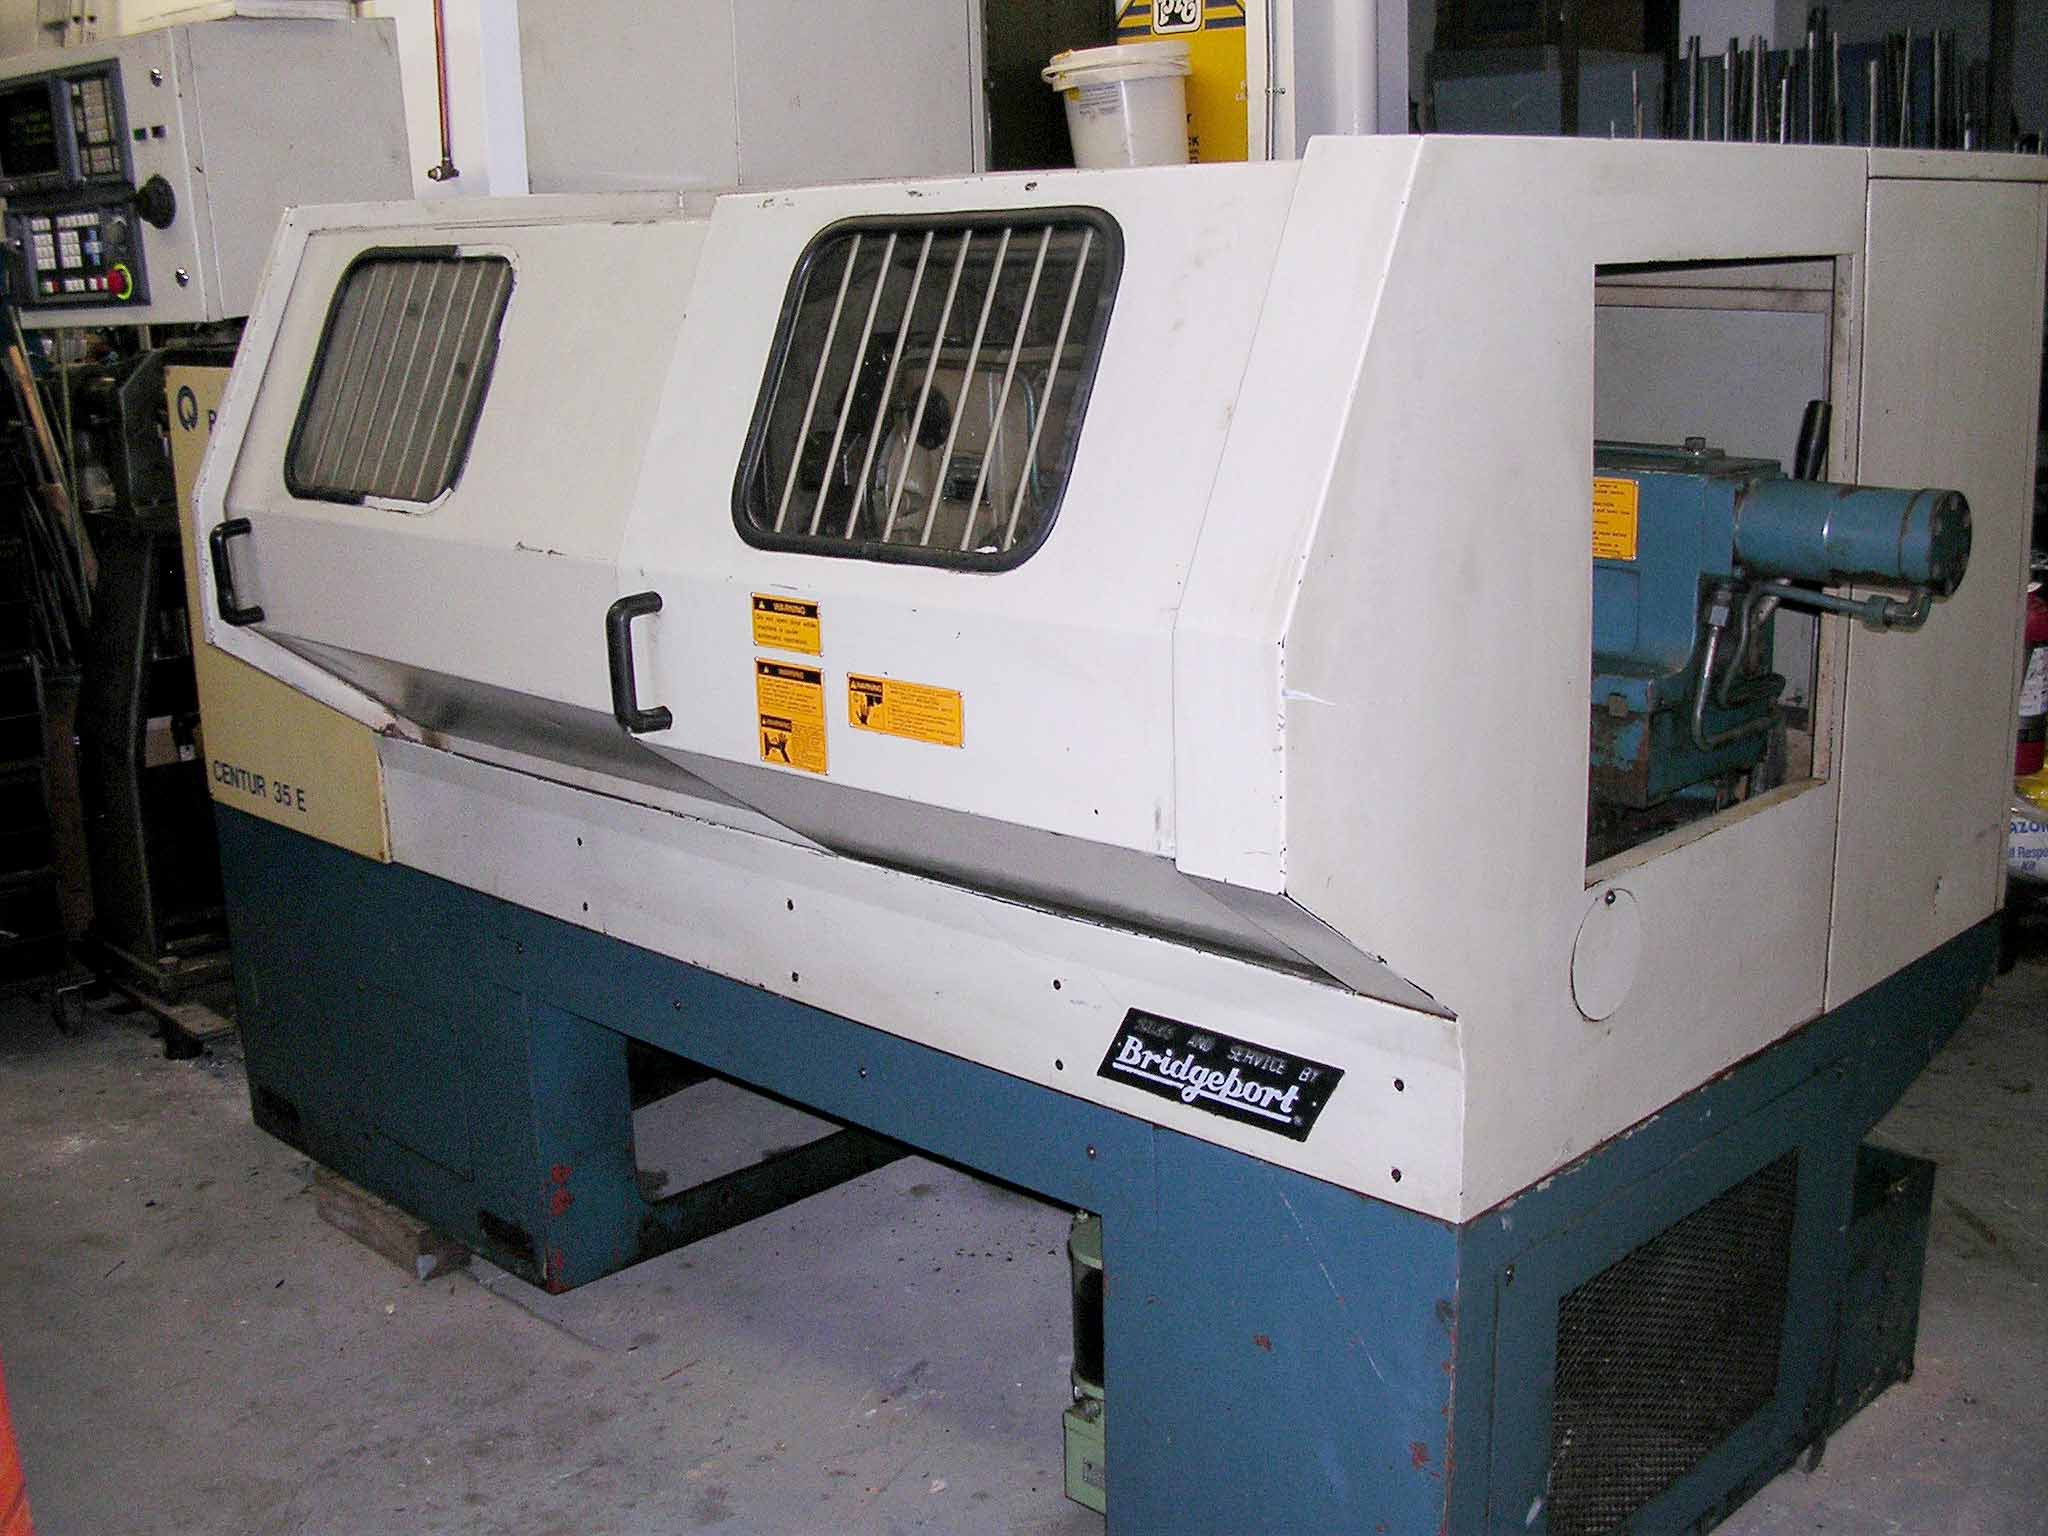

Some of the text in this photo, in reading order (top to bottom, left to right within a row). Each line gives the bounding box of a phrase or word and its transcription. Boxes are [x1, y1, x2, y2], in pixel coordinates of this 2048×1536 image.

[214, 760, 306, 812] CENTUR 35 E
[1115, 1035, 1299, 1113] Bridgeport
